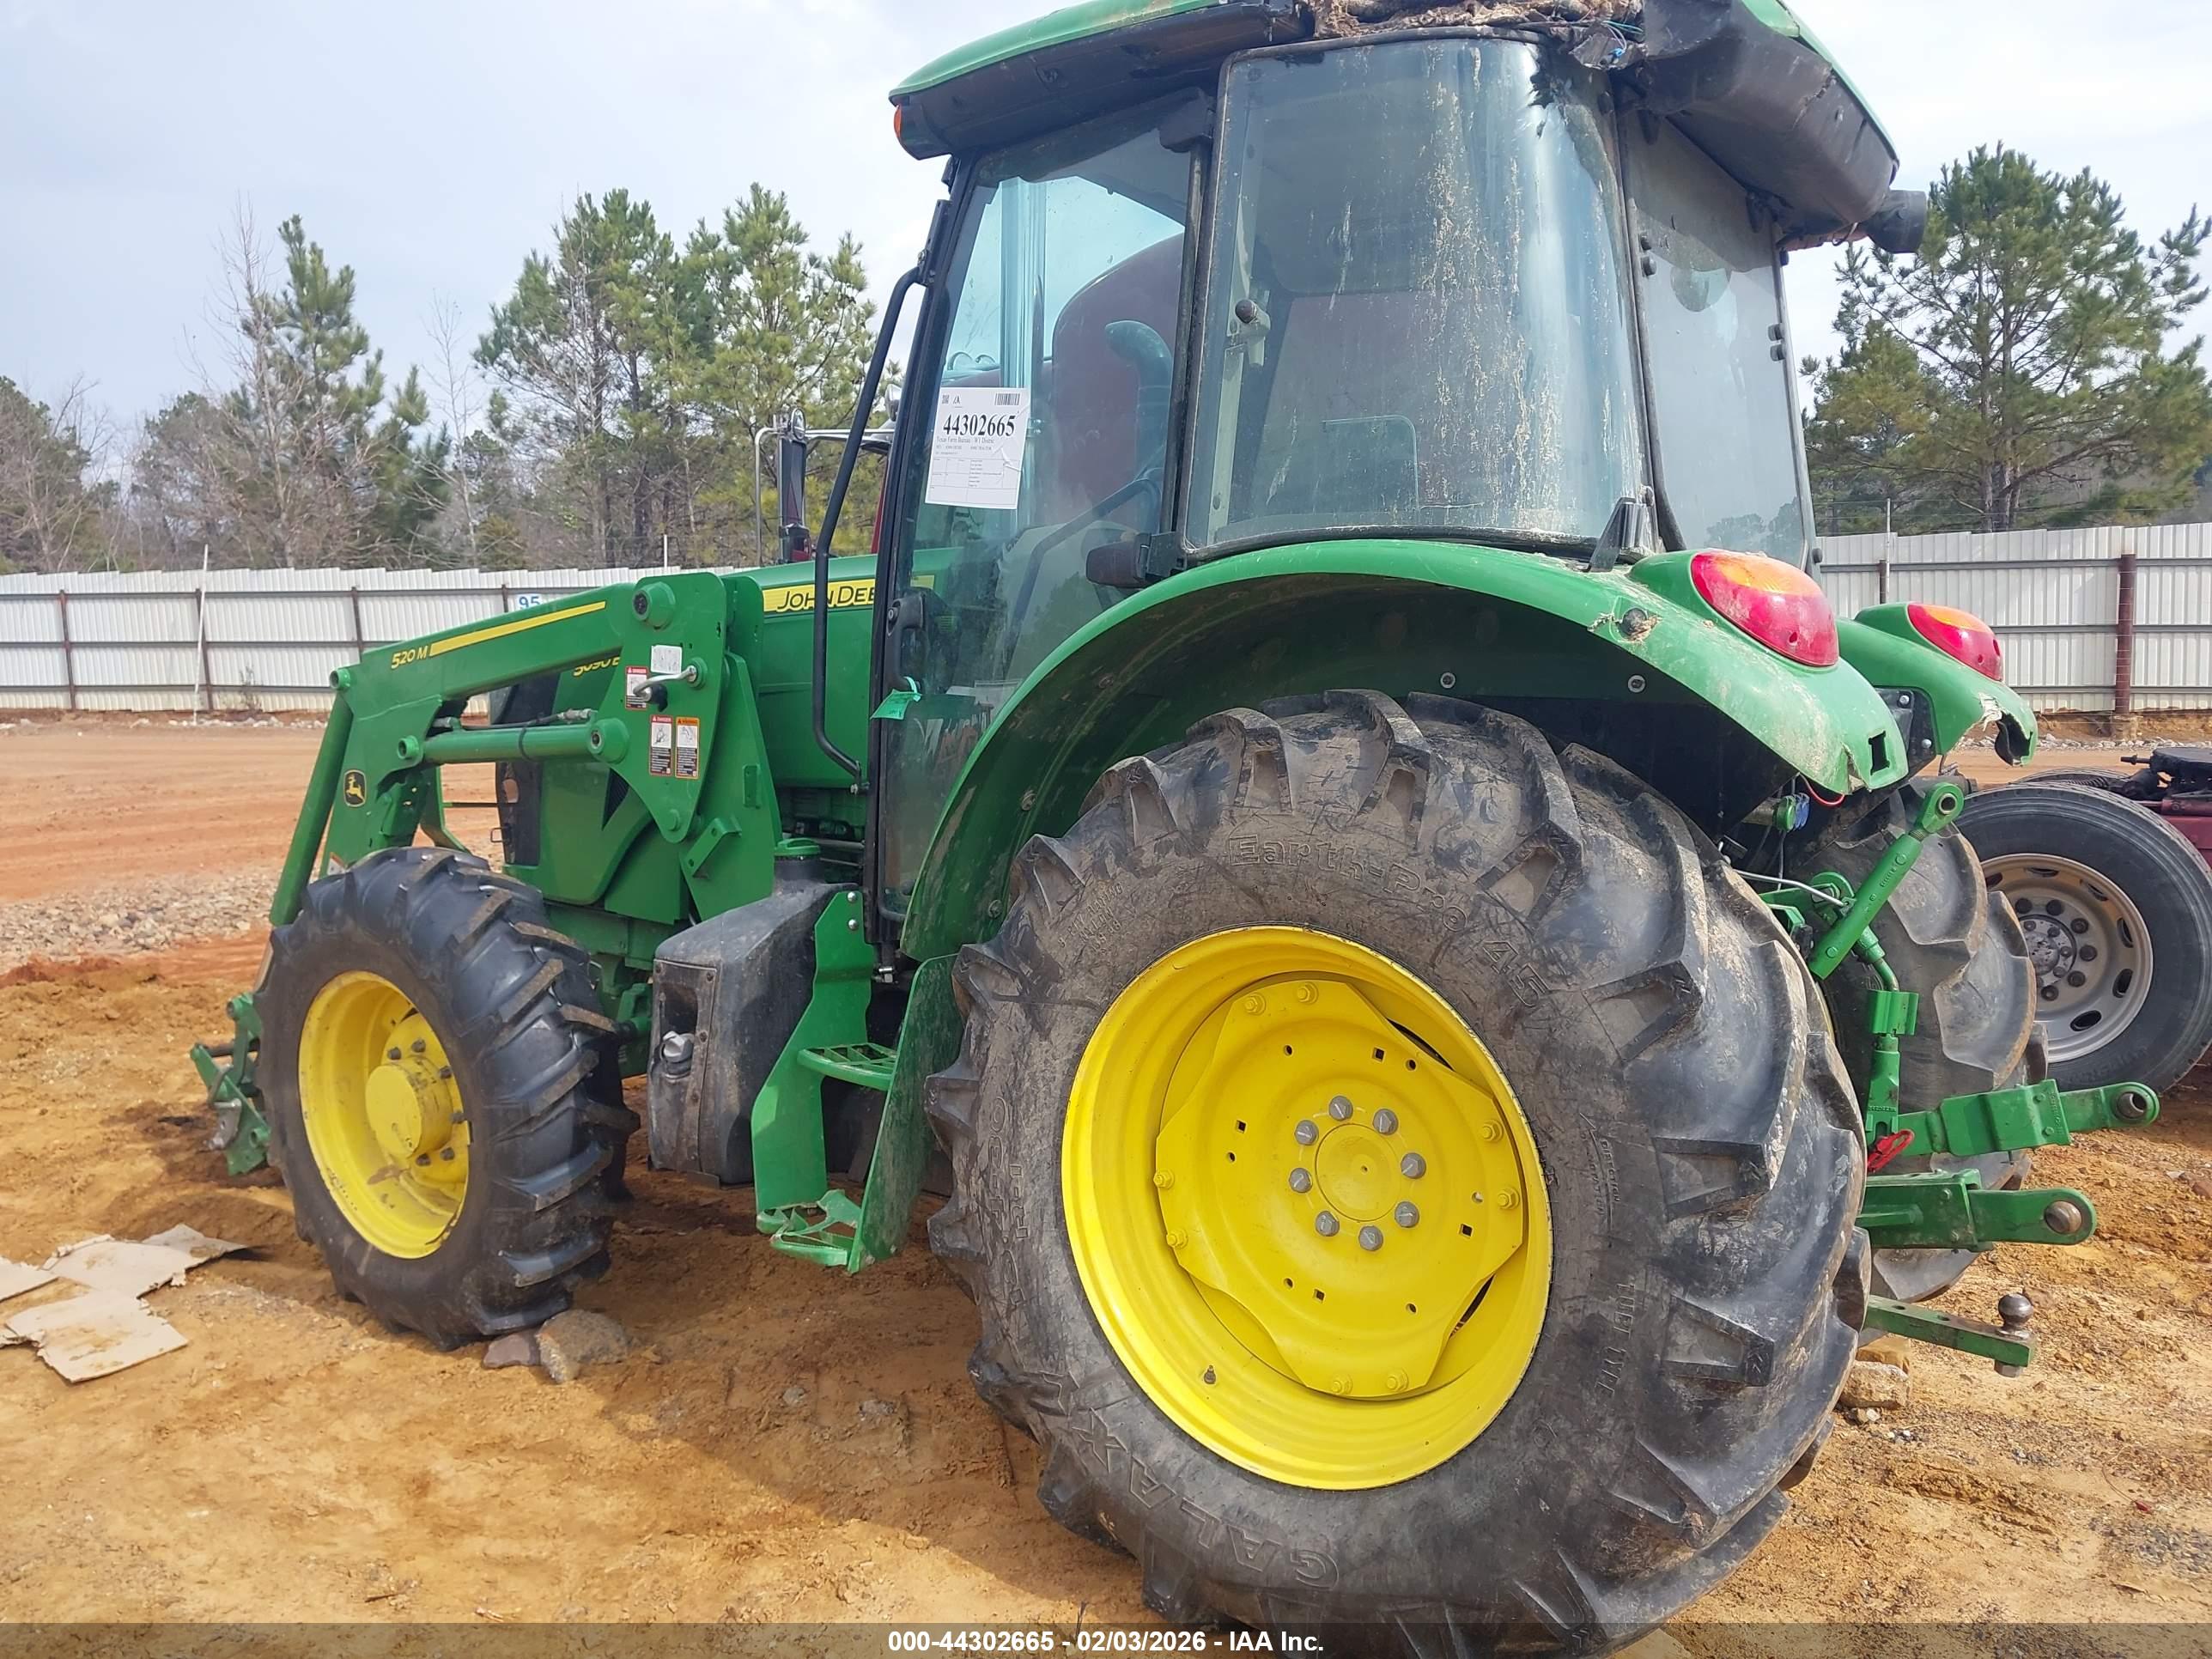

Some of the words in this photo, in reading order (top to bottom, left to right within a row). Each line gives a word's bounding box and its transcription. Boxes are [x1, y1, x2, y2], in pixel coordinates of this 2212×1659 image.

[944, 415, 1016, 436] 44302665
[837, 586, 875, 605] DEE
[391, 649, 416, 670] 520
[416, 645, 428, 660] M
[1229, 834, 1468, 933] Earth-Pro
[1481, 940, 1550, 1007] 45
[1037, 1369, 1340, 1589] GALAXY
